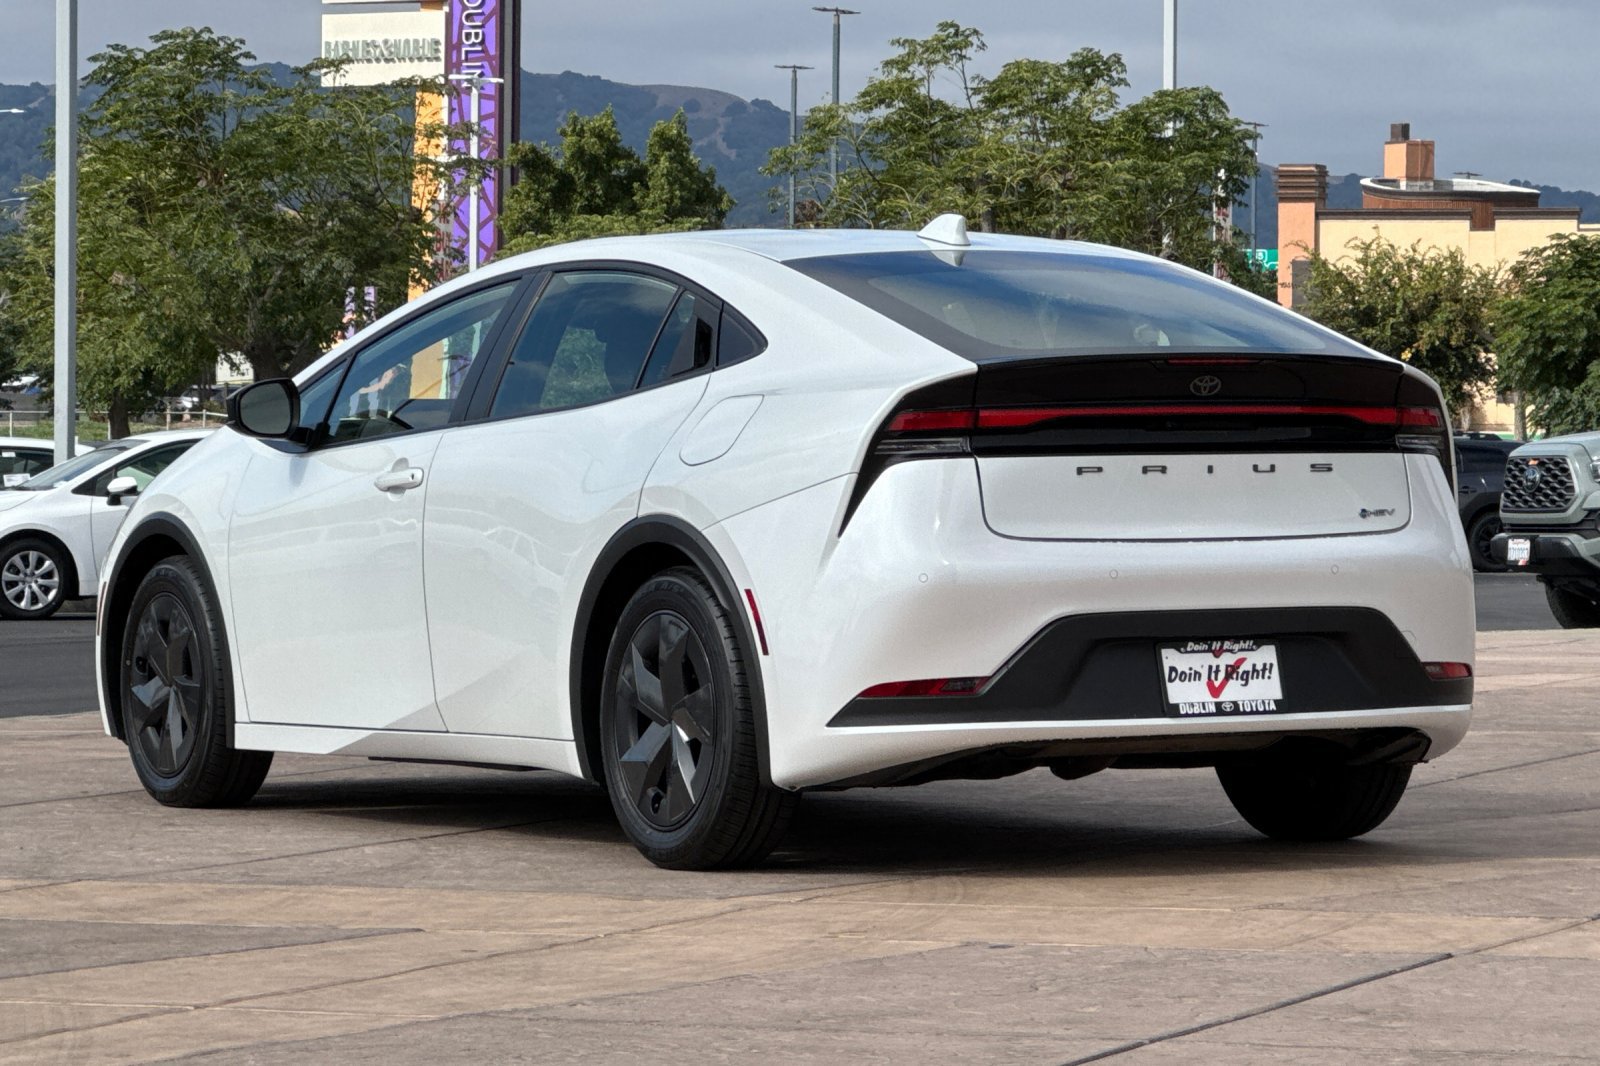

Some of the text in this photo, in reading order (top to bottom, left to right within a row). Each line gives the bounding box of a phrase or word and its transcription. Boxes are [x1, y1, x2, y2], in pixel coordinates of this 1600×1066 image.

[1076, 463, 1333, 476] PRIUS
[1211, 641, 1222, 650] It
[1223, 640, 1254, 653] Right!
[1167, 662, 1274, 687] Doin' It Right!
[1179, 700, 1277, 714] DUBLIN TOYOTA
